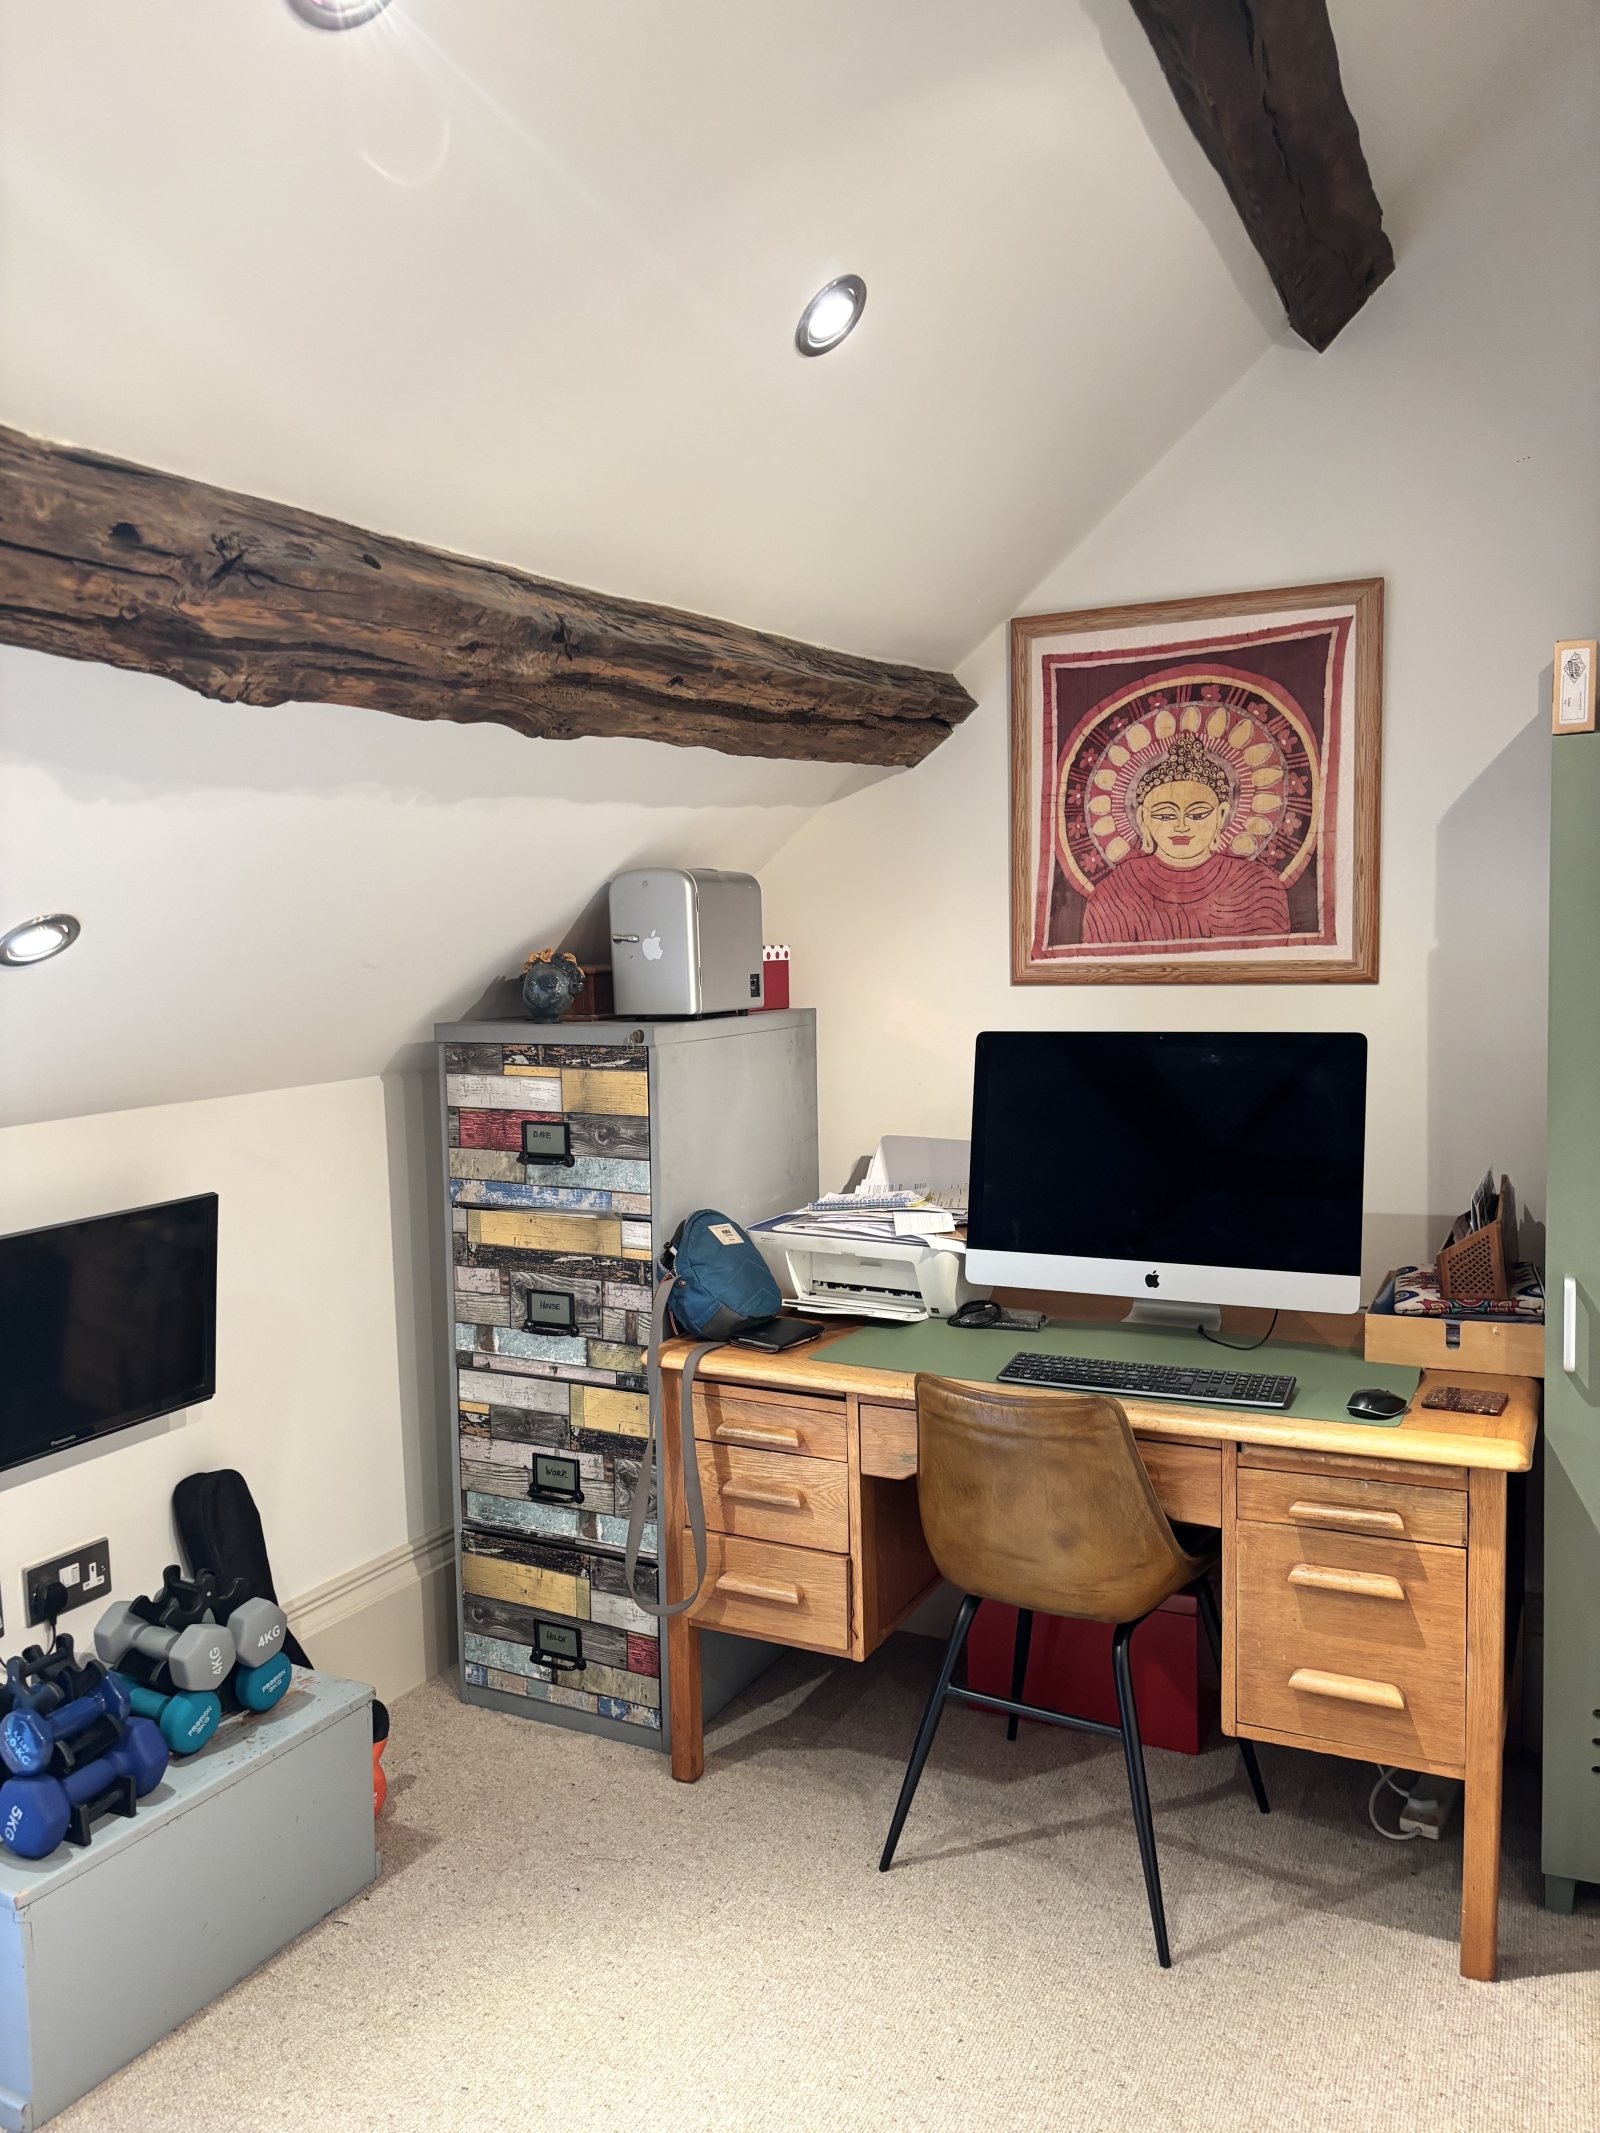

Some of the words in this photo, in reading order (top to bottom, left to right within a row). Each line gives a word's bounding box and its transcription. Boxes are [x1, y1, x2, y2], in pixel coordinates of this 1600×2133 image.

[533, 1130, 551, 1139] DAVE
[546, 1465, 567, 1478] WORK
[257, 1625, 280, 1647] 4KG
[547, 1631, 567, 1643] HELEN
[209, 1646, 222, 1674] 4KG
[187, 1705, 212, 1736] PROIRON
[5, 1805, 23, 1841] 5KG
